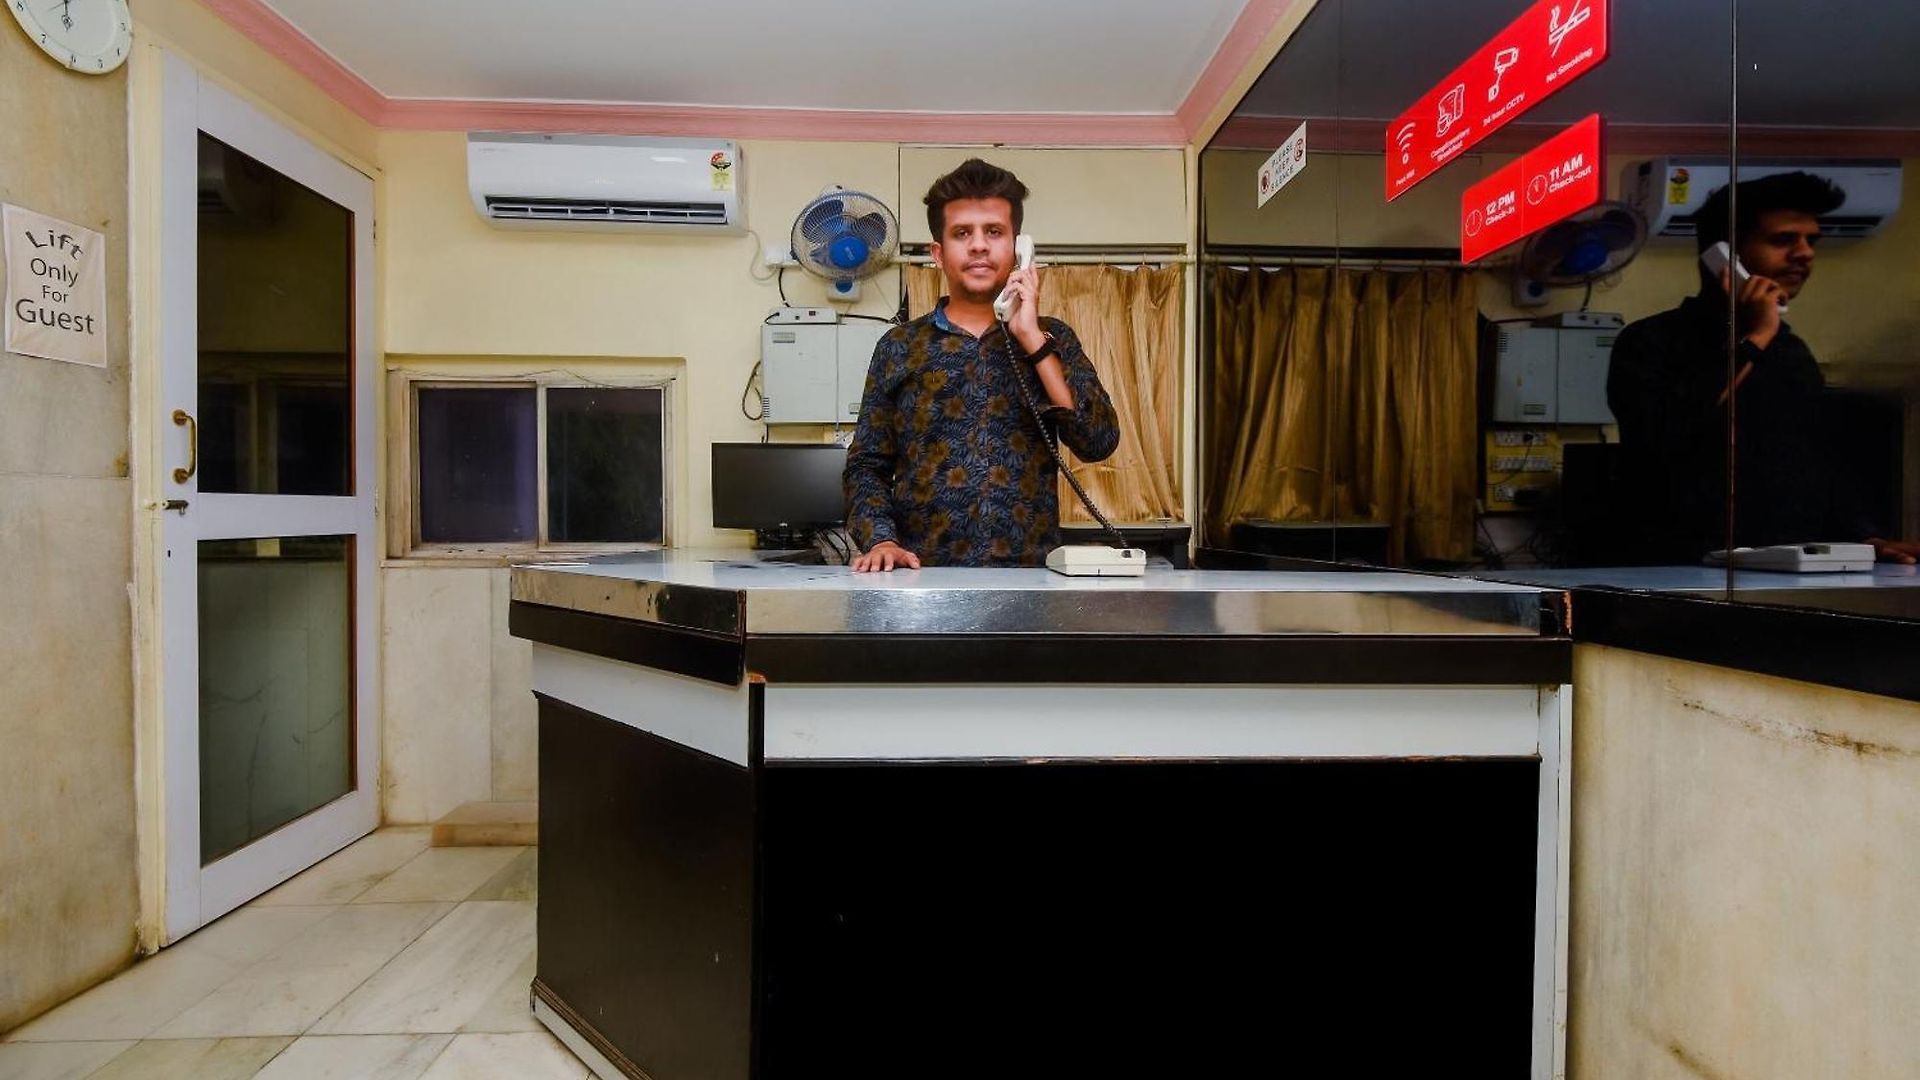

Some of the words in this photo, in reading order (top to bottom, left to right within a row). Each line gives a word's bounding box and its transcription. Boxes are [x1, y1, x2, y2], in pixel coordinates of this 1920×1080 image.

[1546, 71, 1558, 83] No
[1558, 47, 1593, 75] Smoking
[1505, 92, 1526, 111] CCTV
[1549, 165, 1560, 182] 11
[1561, 153, 1583, 177] AM
[1549, 165, 1593, 193] Check-out
[1485, 200, 1497, 217] 12
[1497, 190, 1516, 210] PM
[1485, 206, 1516, 226] Check-in
[30, 257, 79, 288] Only
[42, 284, 69, 304] For
[15, 298, 95, 335] Guest
